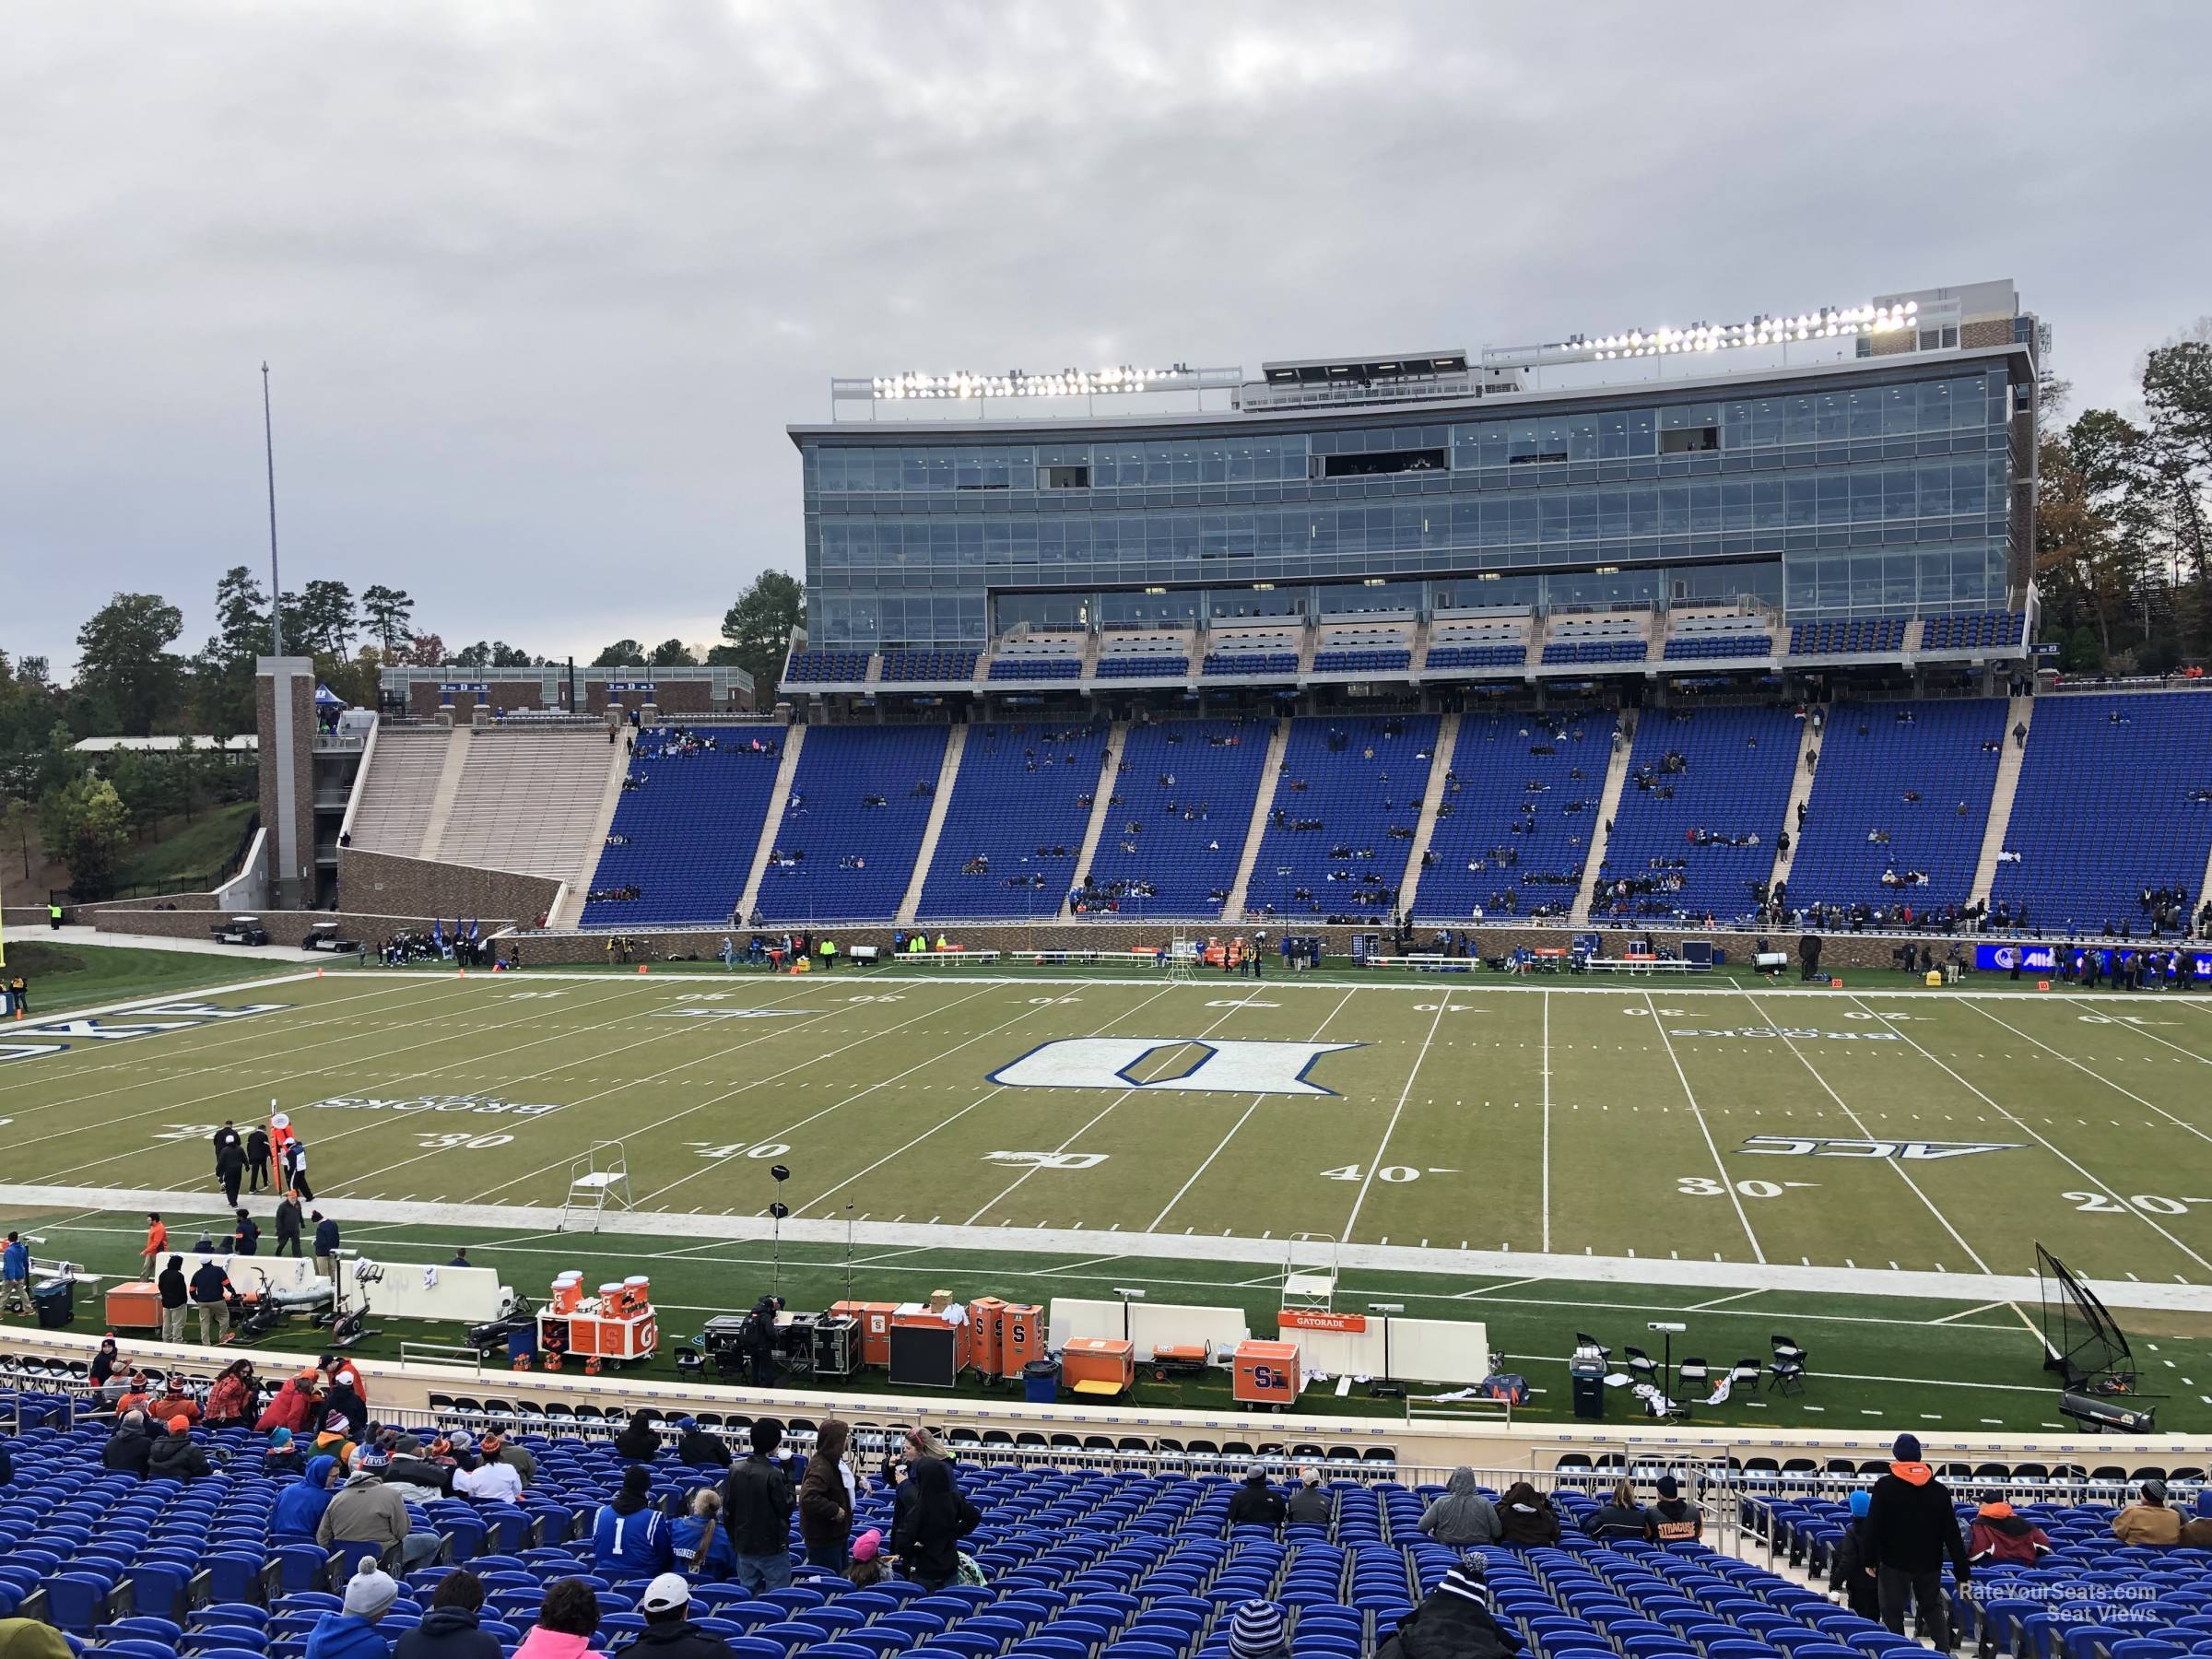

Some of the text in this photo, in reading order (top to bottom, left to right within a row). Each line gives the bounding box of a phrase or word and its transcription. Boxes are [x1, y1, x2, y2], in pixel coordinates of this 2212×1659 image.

[1413, 1004, 1474, 1012] 40
[1623, 1008, 1686, 1017] 30
[1843, 1012, 1912, 1020] 20
[2077, 1016, 2154, 1025] 10
[1668, 1029, 1903, 1040] BROOKS
[984, 1037, 1371, 1097] D
[310, 1098, 559, 1115] BROOKS
[418, 1133, 515, 1149] 30
[1730, 1135, 2037, 1159] ACC
[693, 1142, 792, 1159] 40
[1320, 1164, 1420, 1182] 40
[1677, 1177, 1783, 1197] 30
[2062, 1192, 2189, 1214] 20
[554, 1292, 562, 1302] G
[602, 1296, 611, 1306] G
[976, 1317, 983, 1335] S
[1296, 1317, 1345, 1328] GATORADE
[605, 1327, 619, 1349] S
[641, 1322, 653, 1347] G
[1012, 1324, 1026, 1344] S
[1253, 1365, 1272, 1389] S
[612, 1517, 625, 1555] 1
[1657, 1522, 1696, 1537] SYRACUSE
